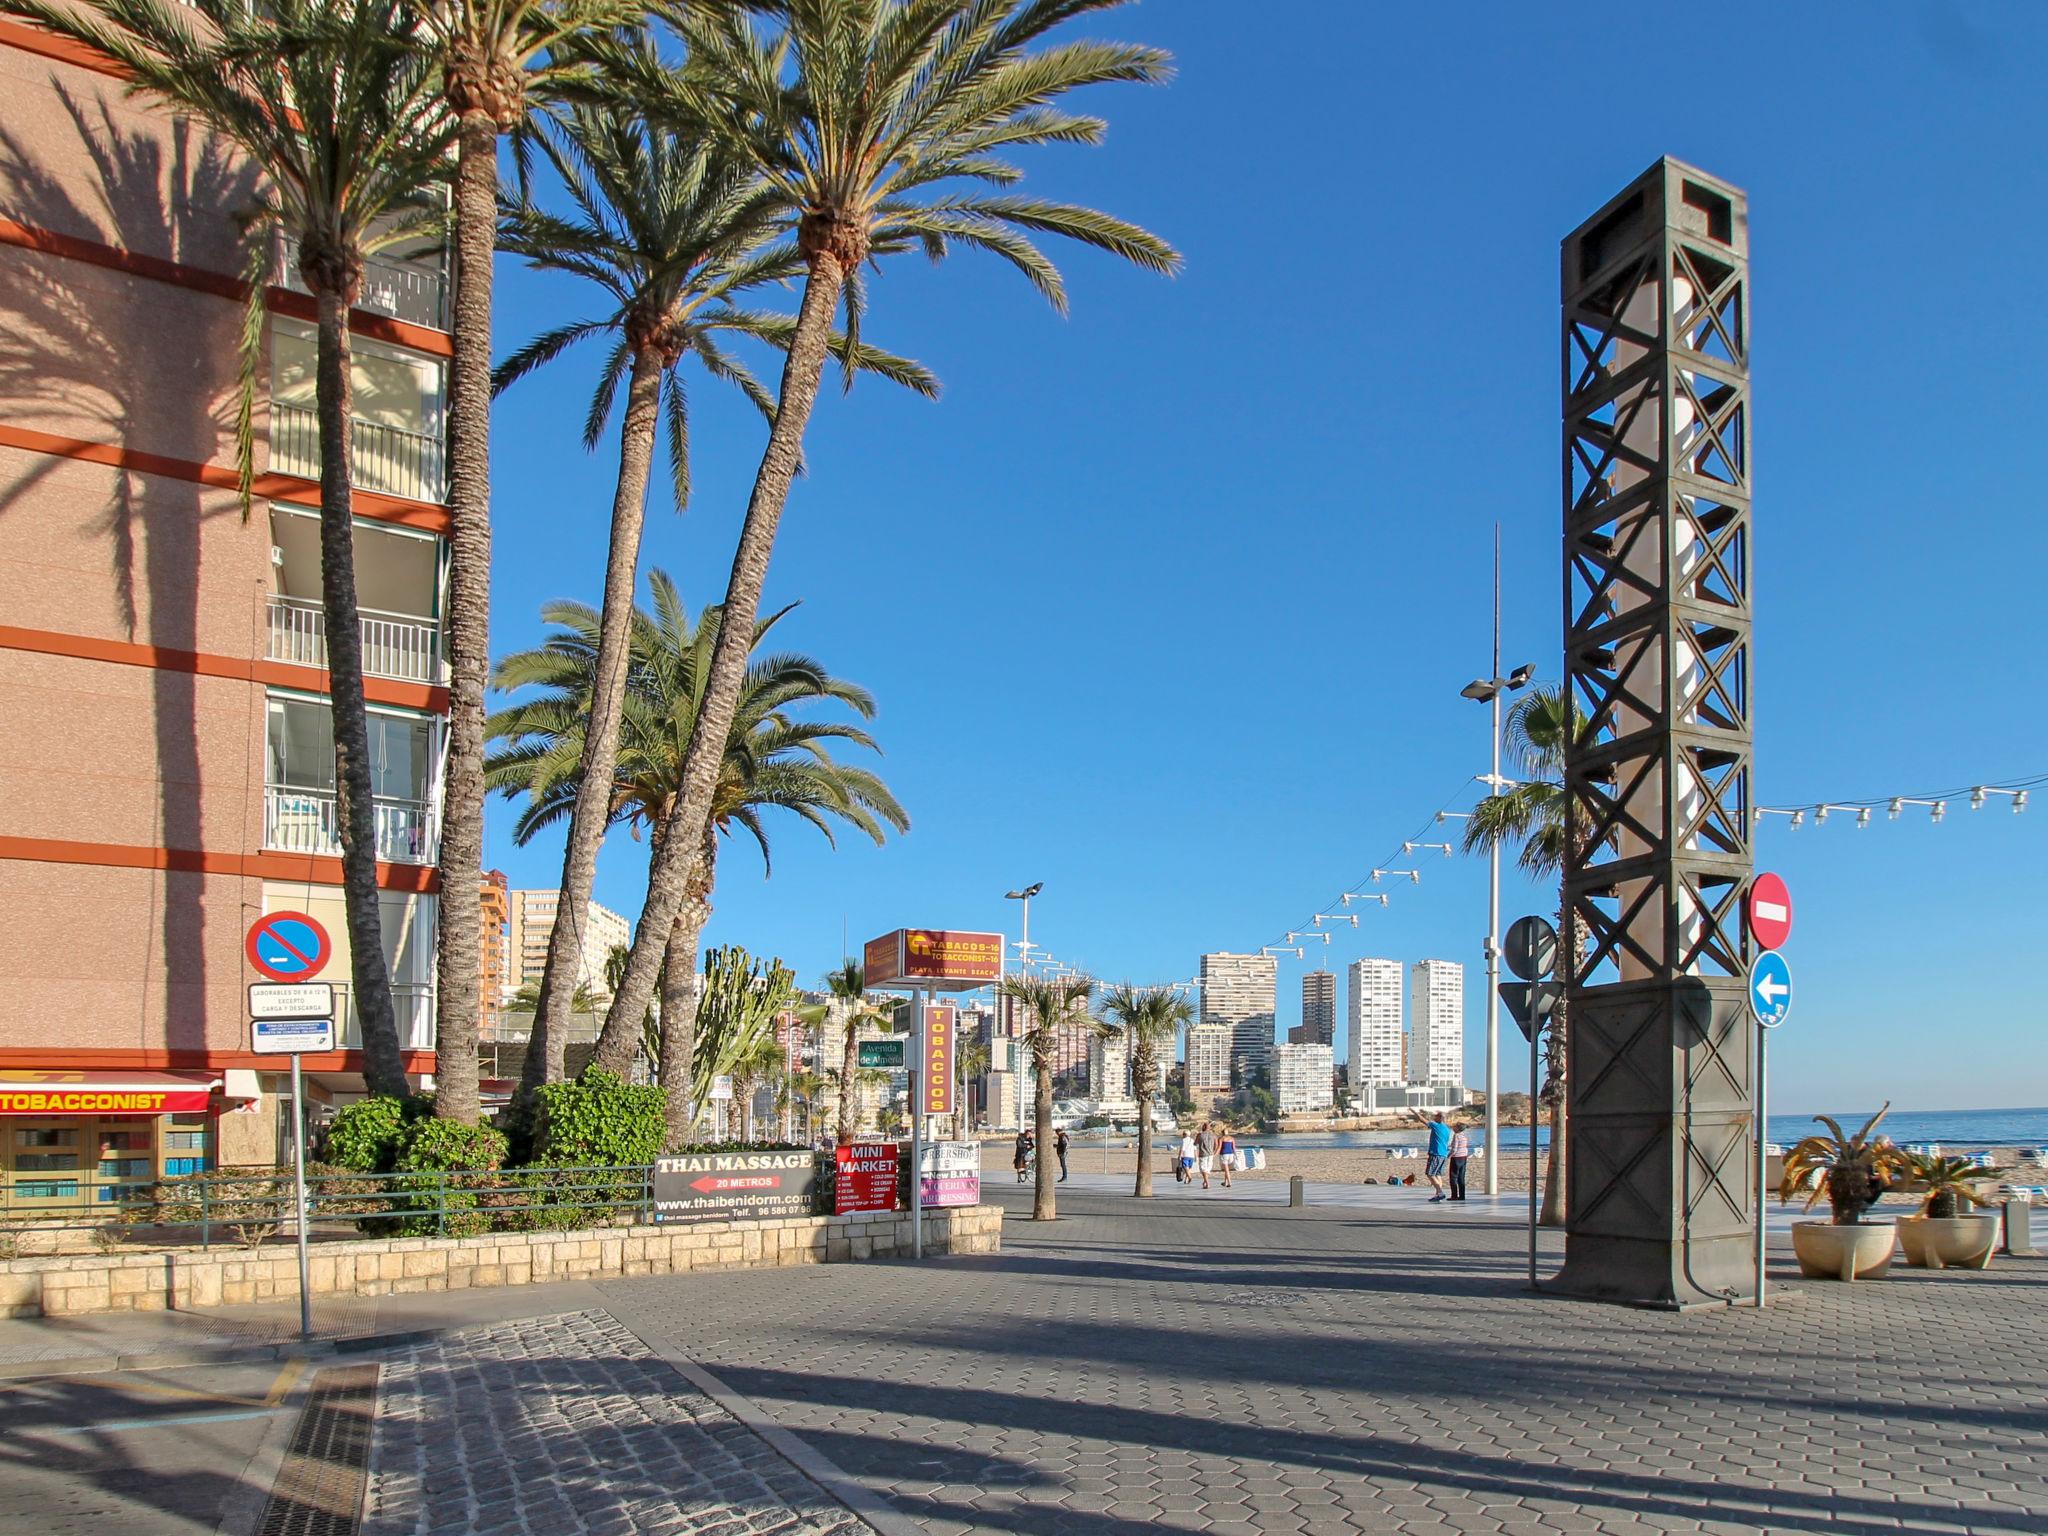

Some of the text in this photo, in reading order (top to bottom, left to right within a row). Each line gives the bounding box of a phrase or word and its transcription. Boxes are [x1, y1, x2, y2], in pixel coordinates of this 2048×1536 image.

[931, 941, 999, 952] TABACOS-16
[932, 953, 999, 963] TOBACCONIST-16
[936, 967, 967, 975] LEVANTE
[865, 1044, 897, 1053] Avenida
[860, 1055, 871, 1064] de
[931, 1010, 945, 1110] TOBACCOS
[0, 1094, 165, 1110] TOBACCONIST
[851, 1146, 883, 1158] MINI
[657, 1154, 812, 1173] THAI MASSAGE
[839, 1160, 894, 1173] MARKET
[928, 1171, 948, 1179] New
[716, 1178, 772, 1188] 20 METROS
[656, 1193, 812, 1210] www.thaibenidorm.com
[676, 1213, 702, 1221] massage
[702, 1211, 730, 1219] benidorm
[732, 1208, 751, 1217] Telf.
[758, 1207, 770, 1216] 96
[771, 1206, 787, 1215] 586
[789, 1206, 799, 1214] 07
